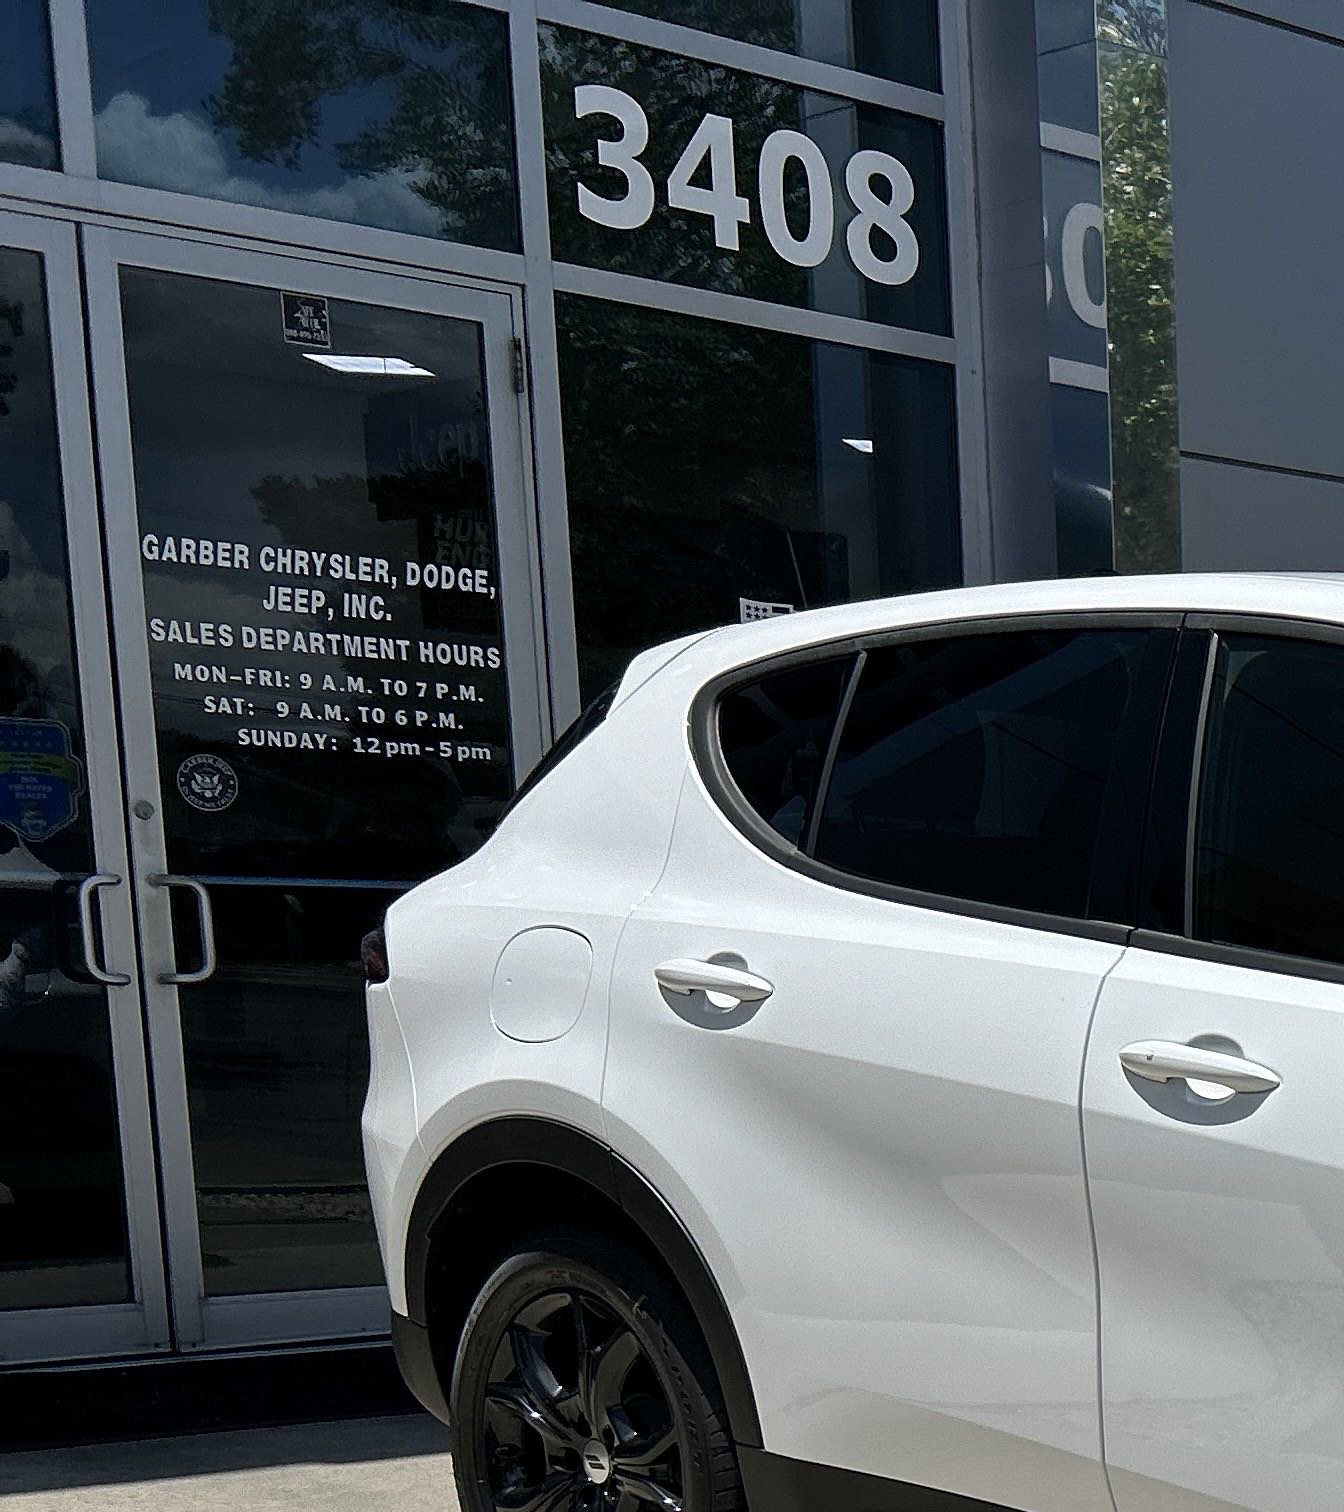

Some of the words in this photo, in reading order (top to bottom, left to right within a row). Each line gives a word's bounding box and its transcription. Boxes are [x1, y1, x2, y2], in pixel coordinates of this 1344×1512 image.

[574, 84, 919, 285] 3408
[142, 534, 249, 570] GARBER
[259, 546, 398, 589] CHRYSLER,
[406, 561, 497, 600] DODGE,
[263, 585, 335, 621] JEEP,
[343, 593, 393, 622] INC.
[150, 617, 234, 647] SALES
[241, 625, 410, 663] DEPARTMENT
[418, 640, 501, 669] HOURS
[299, 673, 313, 690] 9
[321, 674, 373, 695] A.M.
[380, 678, 408, 697] TO
[415, 681, 429, 698] 7
[435, 682, 485, 703] P.M.
[203, 696, 255, 716] SAT:
[276, 701, 290, 718] 9
[299, 702, 350, 723] A.M.
[357, 706, 386, 725] TO
[395, 709, 407, 726] 6
[415, 710, 464, 730] P.M.
[237, 728, 338, 751] SUNDAY:
